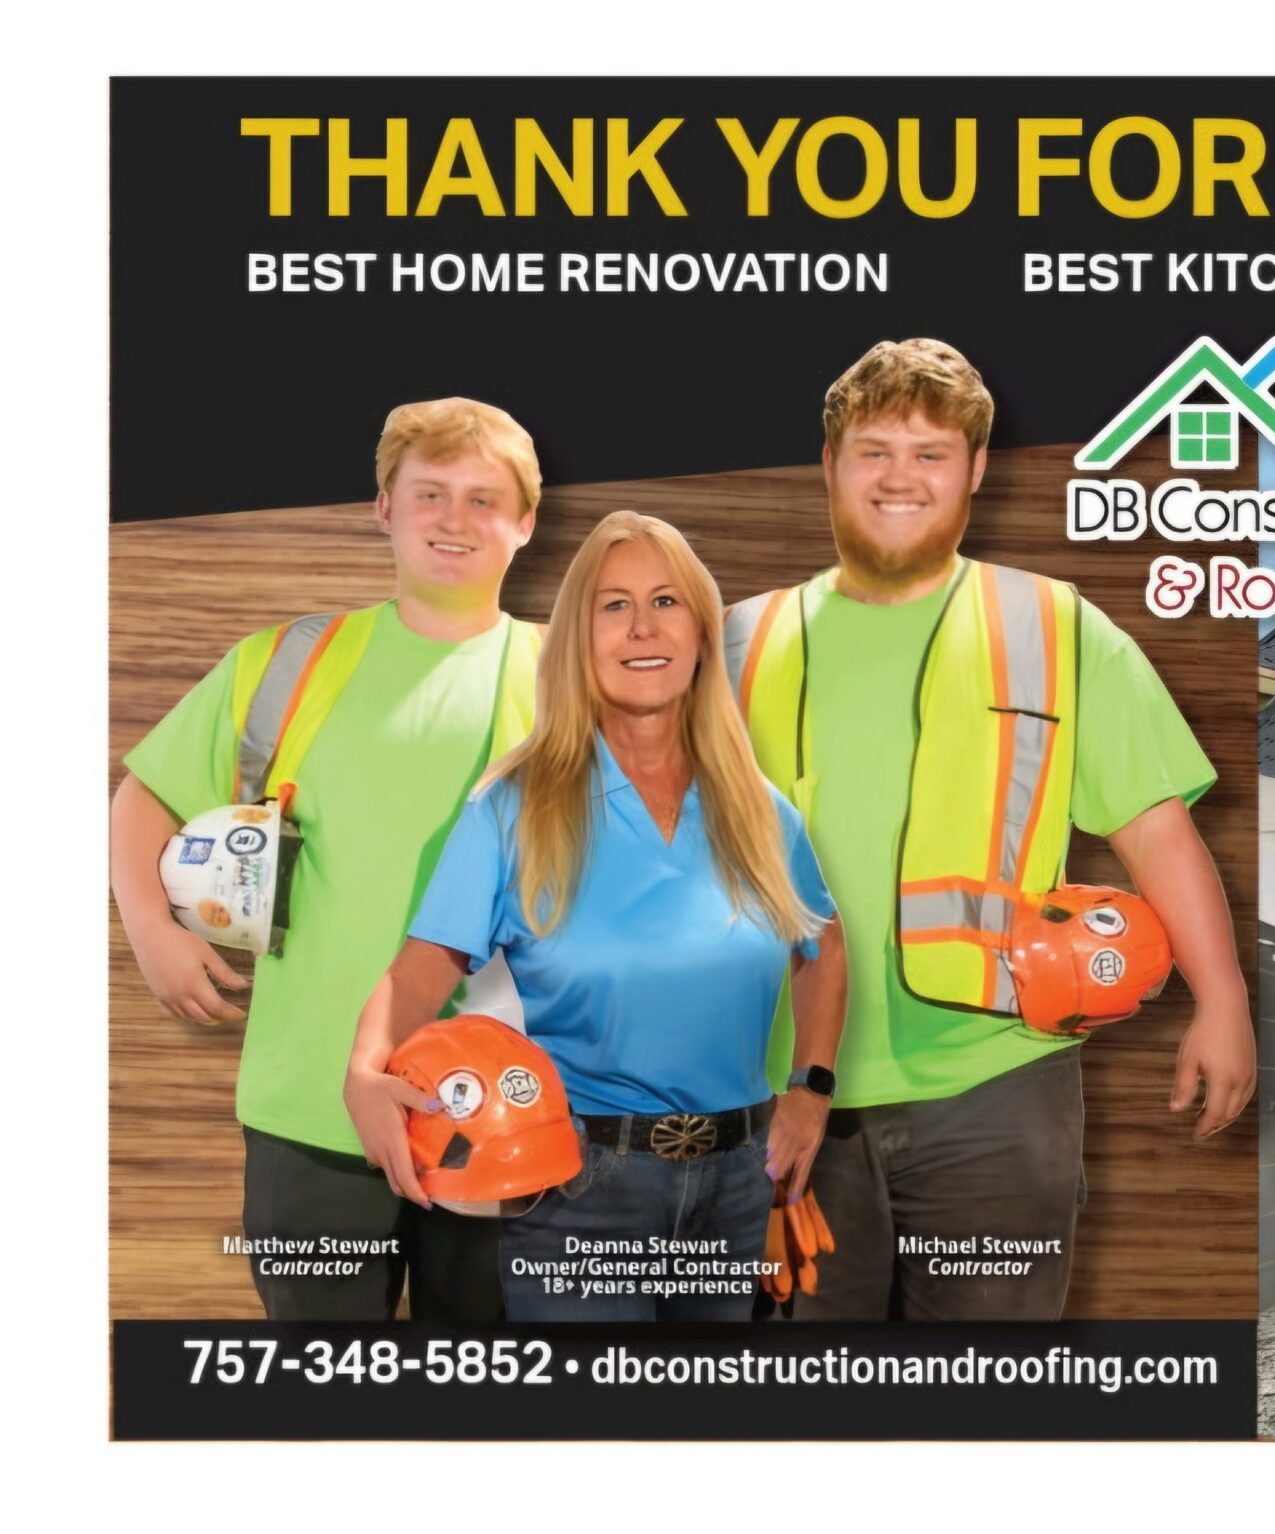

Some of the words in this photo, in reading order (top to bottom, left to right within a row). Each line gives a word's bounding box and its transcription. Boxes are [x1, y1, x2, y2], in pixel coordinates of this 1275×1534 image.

[241, 118, 687, 218] THANK
[716, 116, 976, 219] YOU
[1018, 116, 1270, 219] FOR
[248, 253, 377, 292] BEST
[392, 253, 544, 292] HOME
[560, 253, 888, 292] RENOVATION
[1024, 253, 1153, 292] BEST
[1073, 486, 1140, 532] DB
[1153, 564, 1198, 610] &
[223, 1236, 314, 1254] Matthew
[319, 1236, 400, 1254] Stewart
[565, 1237, 643, 1254] Deanna
[648, 1237, 728, 1254] Stewart
[898, 1236, 977, 1254] Michael
[982, 1236, 1062, 1254] Stewart
[259, 1258, 363, 1275] Contractor
[511, 1258, 667, 1276] Owner/General
[673, 1258, 782, 1276] Contractor
[928, 1258, 1033, 1275] Contractor
[580, 1279, 636, 1299] years
[640, 1277, 753, 1298] experience
[183, 1339, 553, 1384] 757-348-5852
[591, 1346, 1218, 1393] dbconstructionandroofing.com
